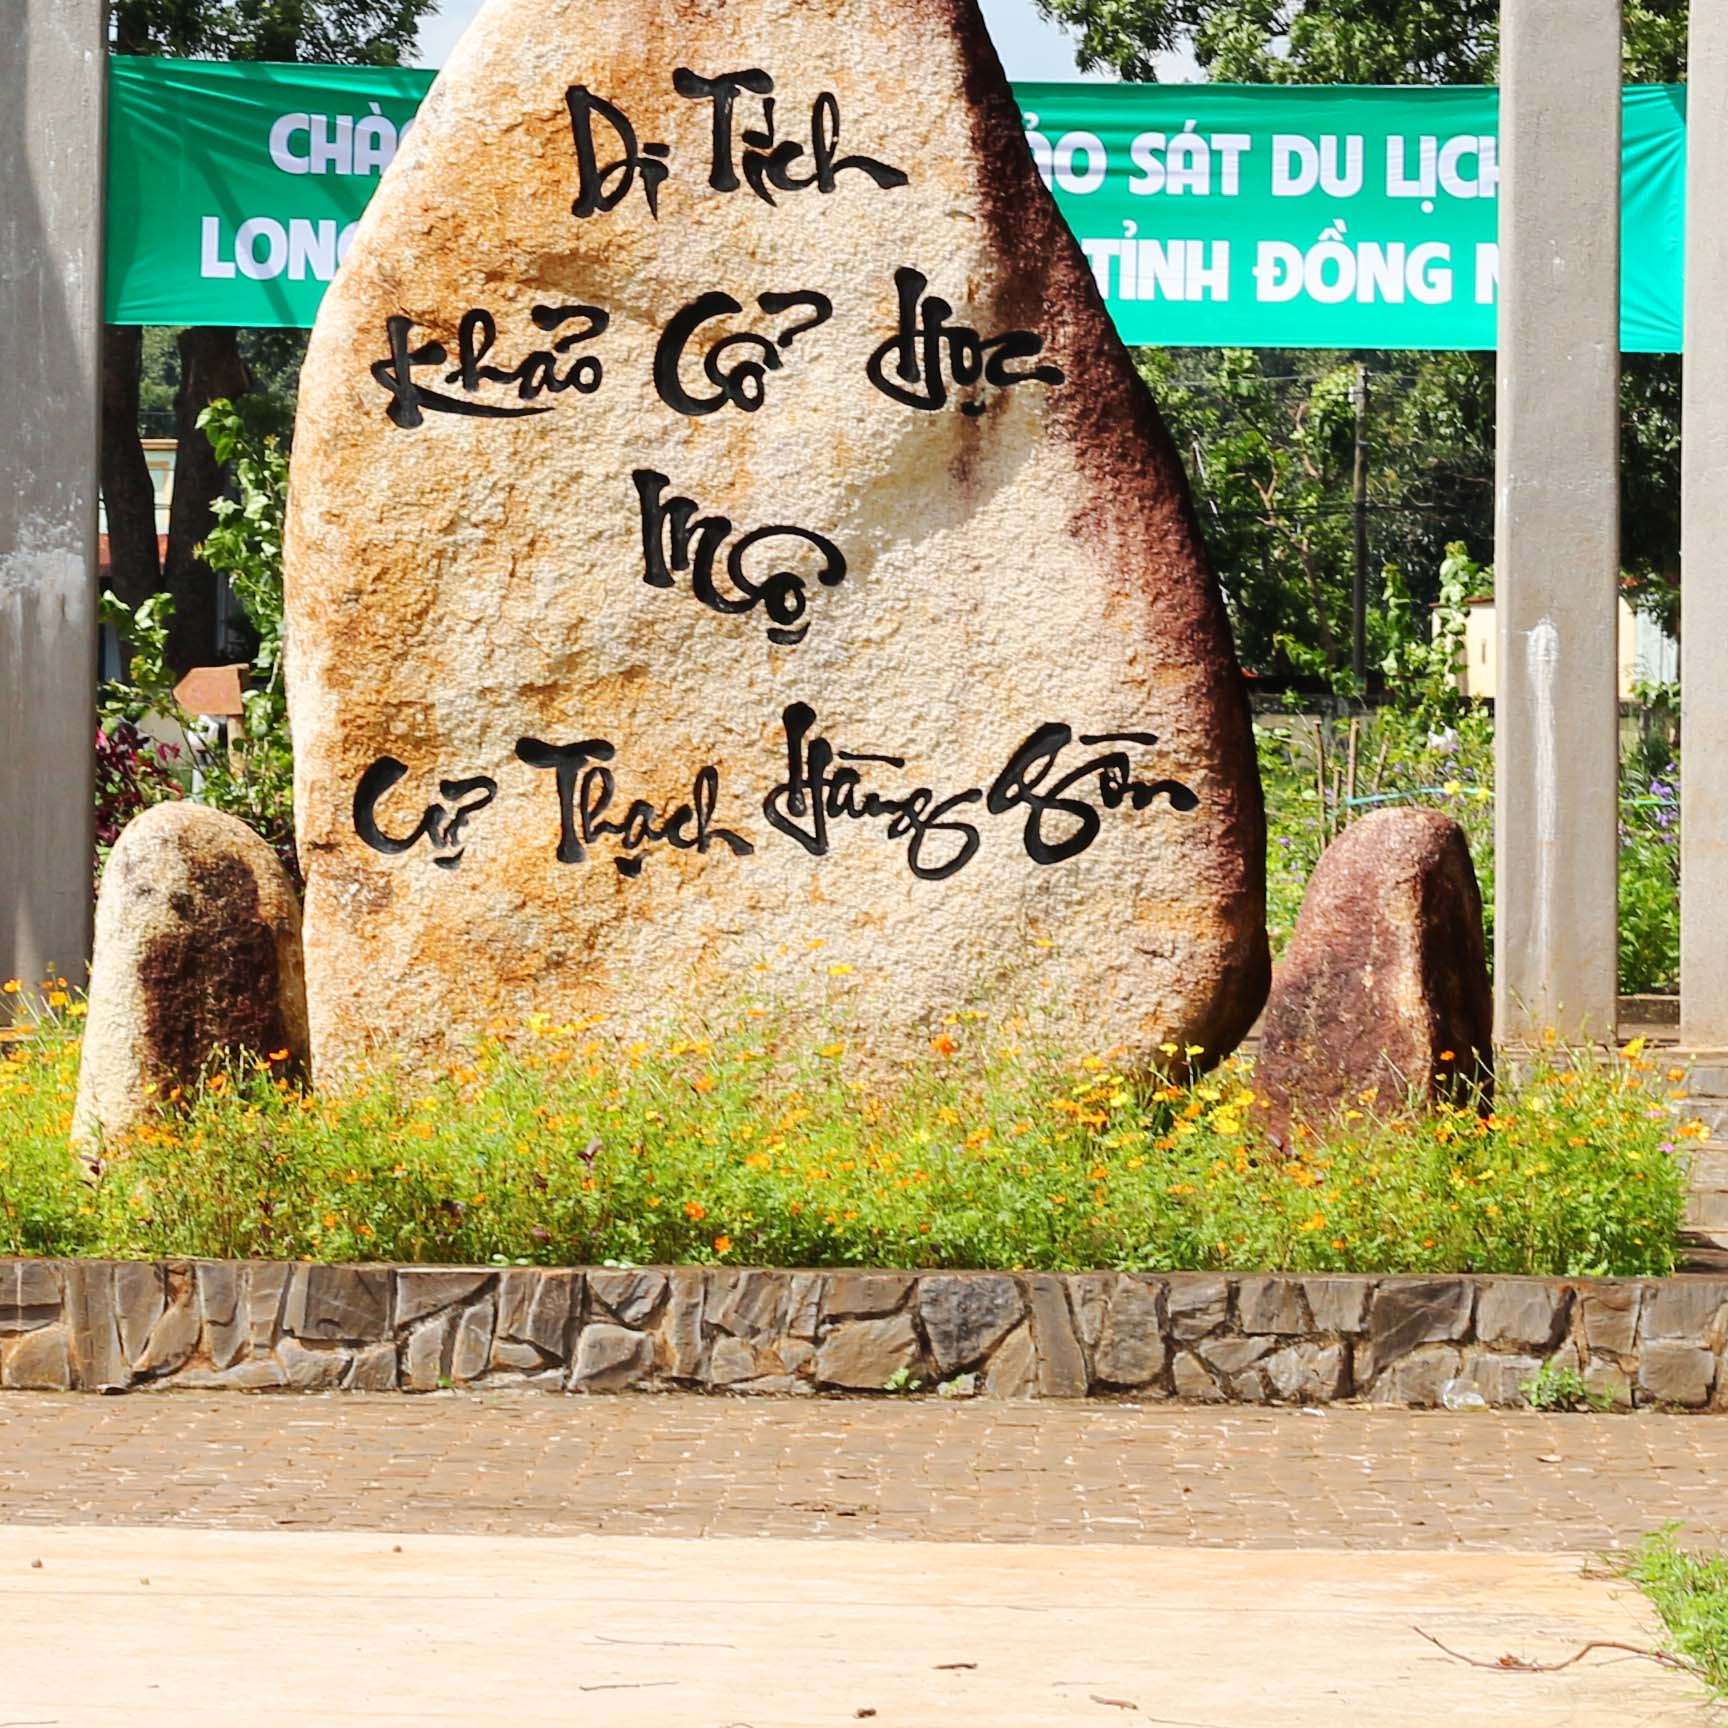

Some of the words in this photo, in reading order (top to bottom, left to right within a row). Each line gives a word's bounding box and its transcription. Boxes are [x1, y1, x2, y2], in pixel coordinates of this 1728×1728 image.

[268, 101, 415, 176] CHÀ
[1128, 119, 1252, 196] SÁT
[1271, 134, 1365, 198] DU
[564, 84, 670, 220] Di
[673, 67, 909, 207] Tích
[200, 215, 362, 281] LON
[1081, 219, 1230, 302] TỈNH
[1251, 218, 1454, 304] ĐỒNG
[371, 304, 610, 429] Khảo
[653, 290, 834, 416] Cổ
[866, 267, 1066, 416] Học
[632, 469, 847, 646] Mộ
[515, 737, 754, 874] Thạch
[762, 700, 982, 880] Hàng
[987, 721, 1200, 866] Gòn
